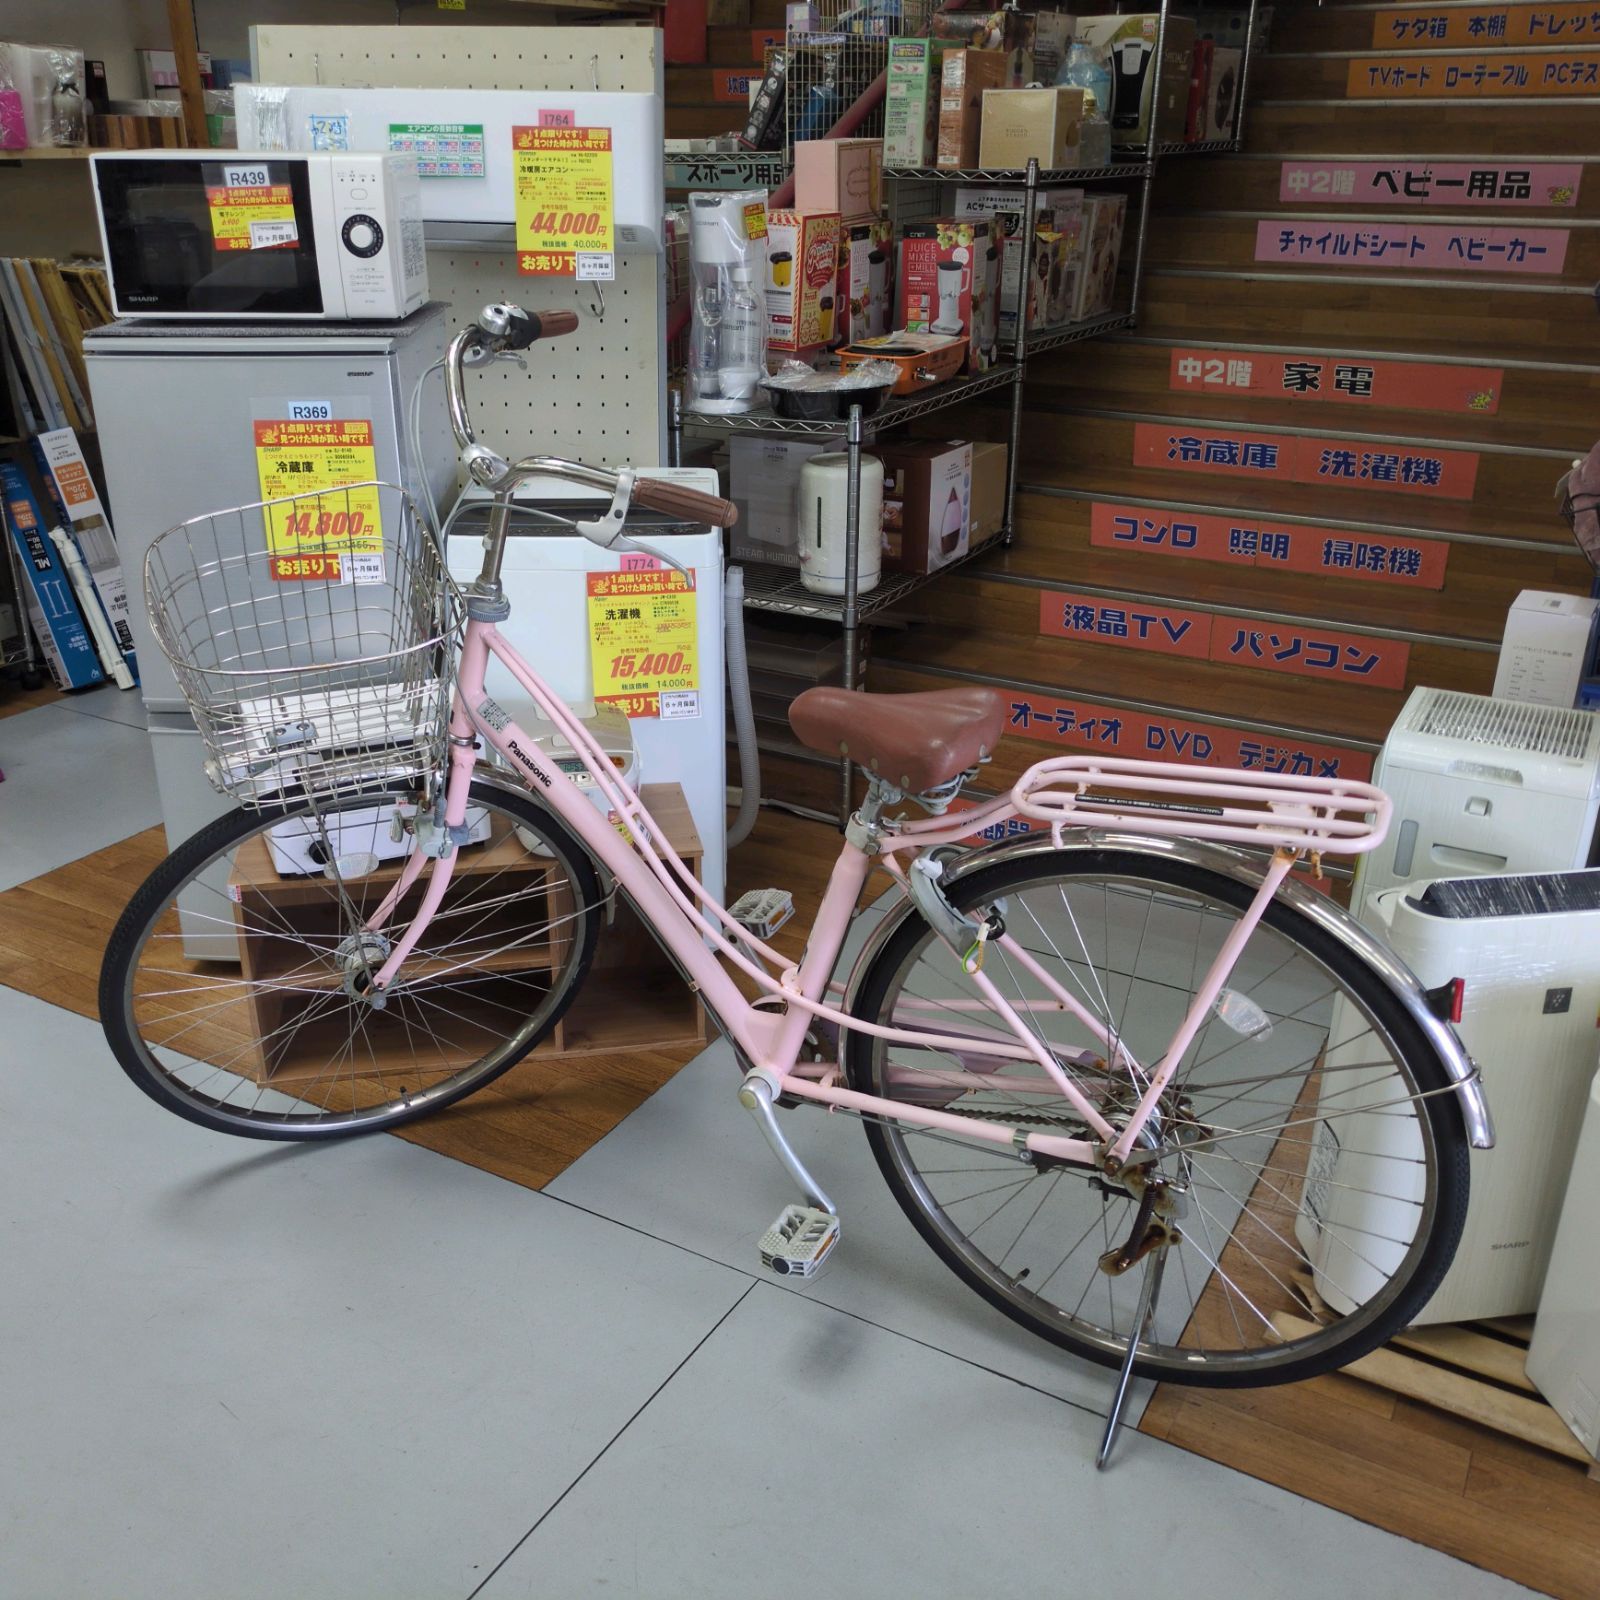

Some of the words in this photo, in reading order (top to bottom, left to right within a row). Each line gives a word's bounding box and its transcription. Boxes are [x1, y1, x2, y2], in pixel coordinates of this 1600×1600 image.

[1392, 16, 1448, 39] ゲタ箱
[1468, 14, 1507, 38] 本棚
[230, 171, 265, 186] R439
[1286, 168, 1356, 196] 中2階
[1370, 168, 1532, 200] ベビー用品
[908, 242, 937, 252] JUICE
[908, 252, 937, 262] MIXER
[1279, 230, 1426, 259] チャイルドシート
[1447, 236, 1548, 262] ベビーカー
[1177, 356, 1254, 389] 中2階
[293, 406, 328, 419] R369
[276, 461, 315, 474] 冷蔵庫
[1167, 436, 1280, 470] 冷蔵庫
[1318, 449, 1444, 486] 洗濯機
[736, 546, 764, 560] STEAM
[1112, 516, 1199, 549] コンロ
[1229, 527, 1291, 560] 照明
[1322, 538, 1423, 577] 掃除機
[605, 608, 641, 621] 洗濯機
[1062, 602, 1193, 643] 液晶TV
[1229, 629, 1381, 675] パソコン
[1009, 702, 1123, 745] オーディオ
[1145, 725, 1213, 759] DVD
[1238, 741, 1341, 779] デジカメ
[507, 740, 553, 788] Panasonic
